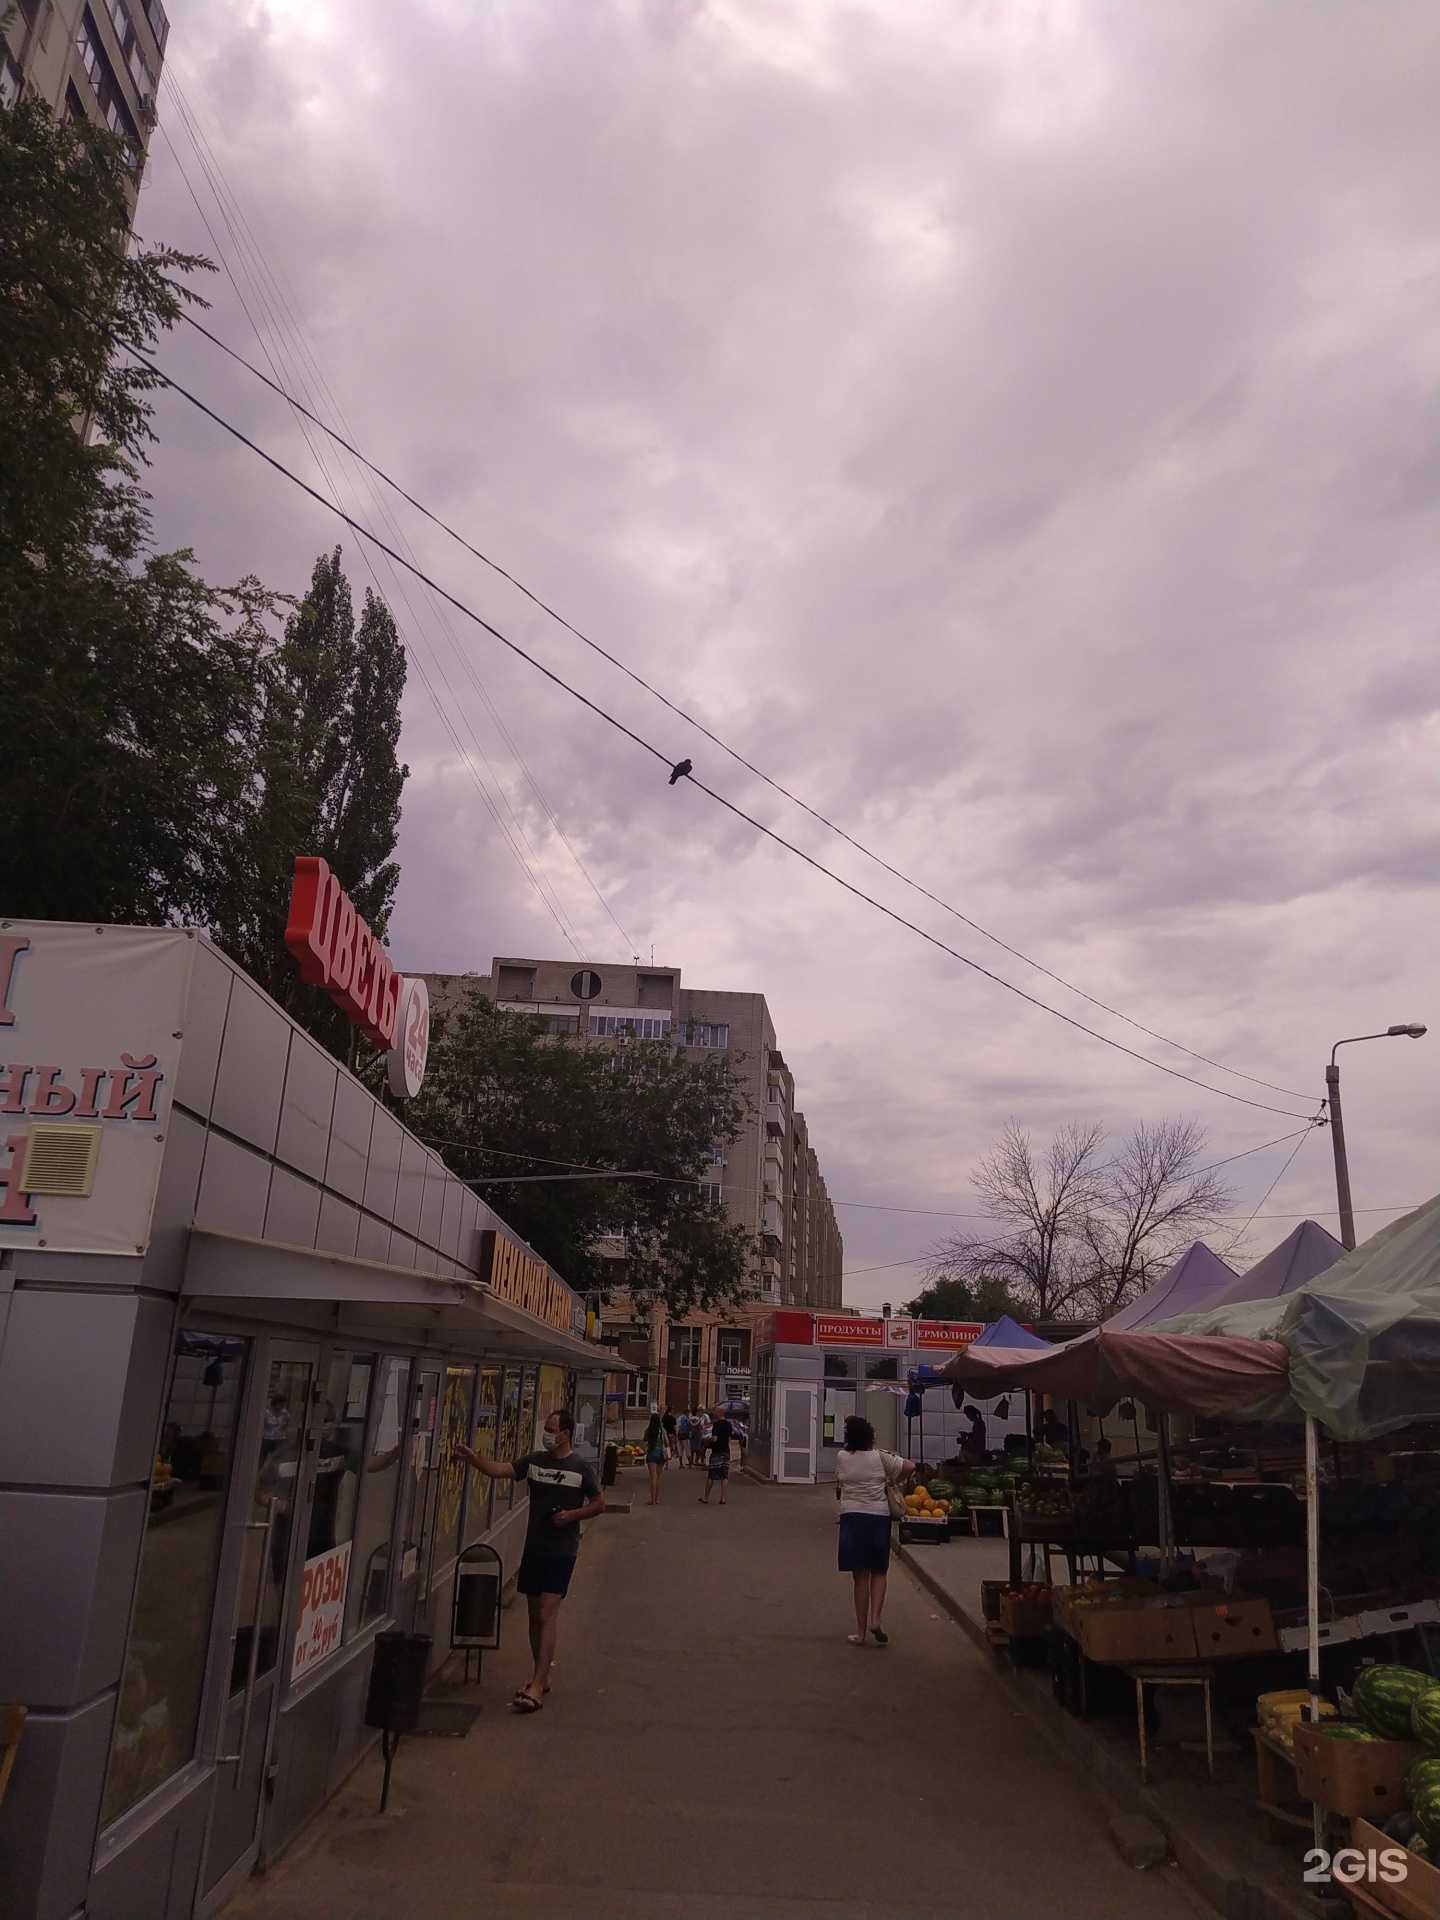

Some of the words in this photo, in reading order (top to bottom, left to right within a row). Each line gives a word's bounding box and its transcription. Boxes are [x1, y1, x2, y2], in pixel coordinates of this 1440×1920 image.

[308, 857, 403, 1050] ЦВЕТЫ
[408, 991, 428, 1055] 24
[819, 1324, 881, 1336] ПРОДУКТЫ
[919, 1329, 980, 1341] ЕРМОЛИНО
